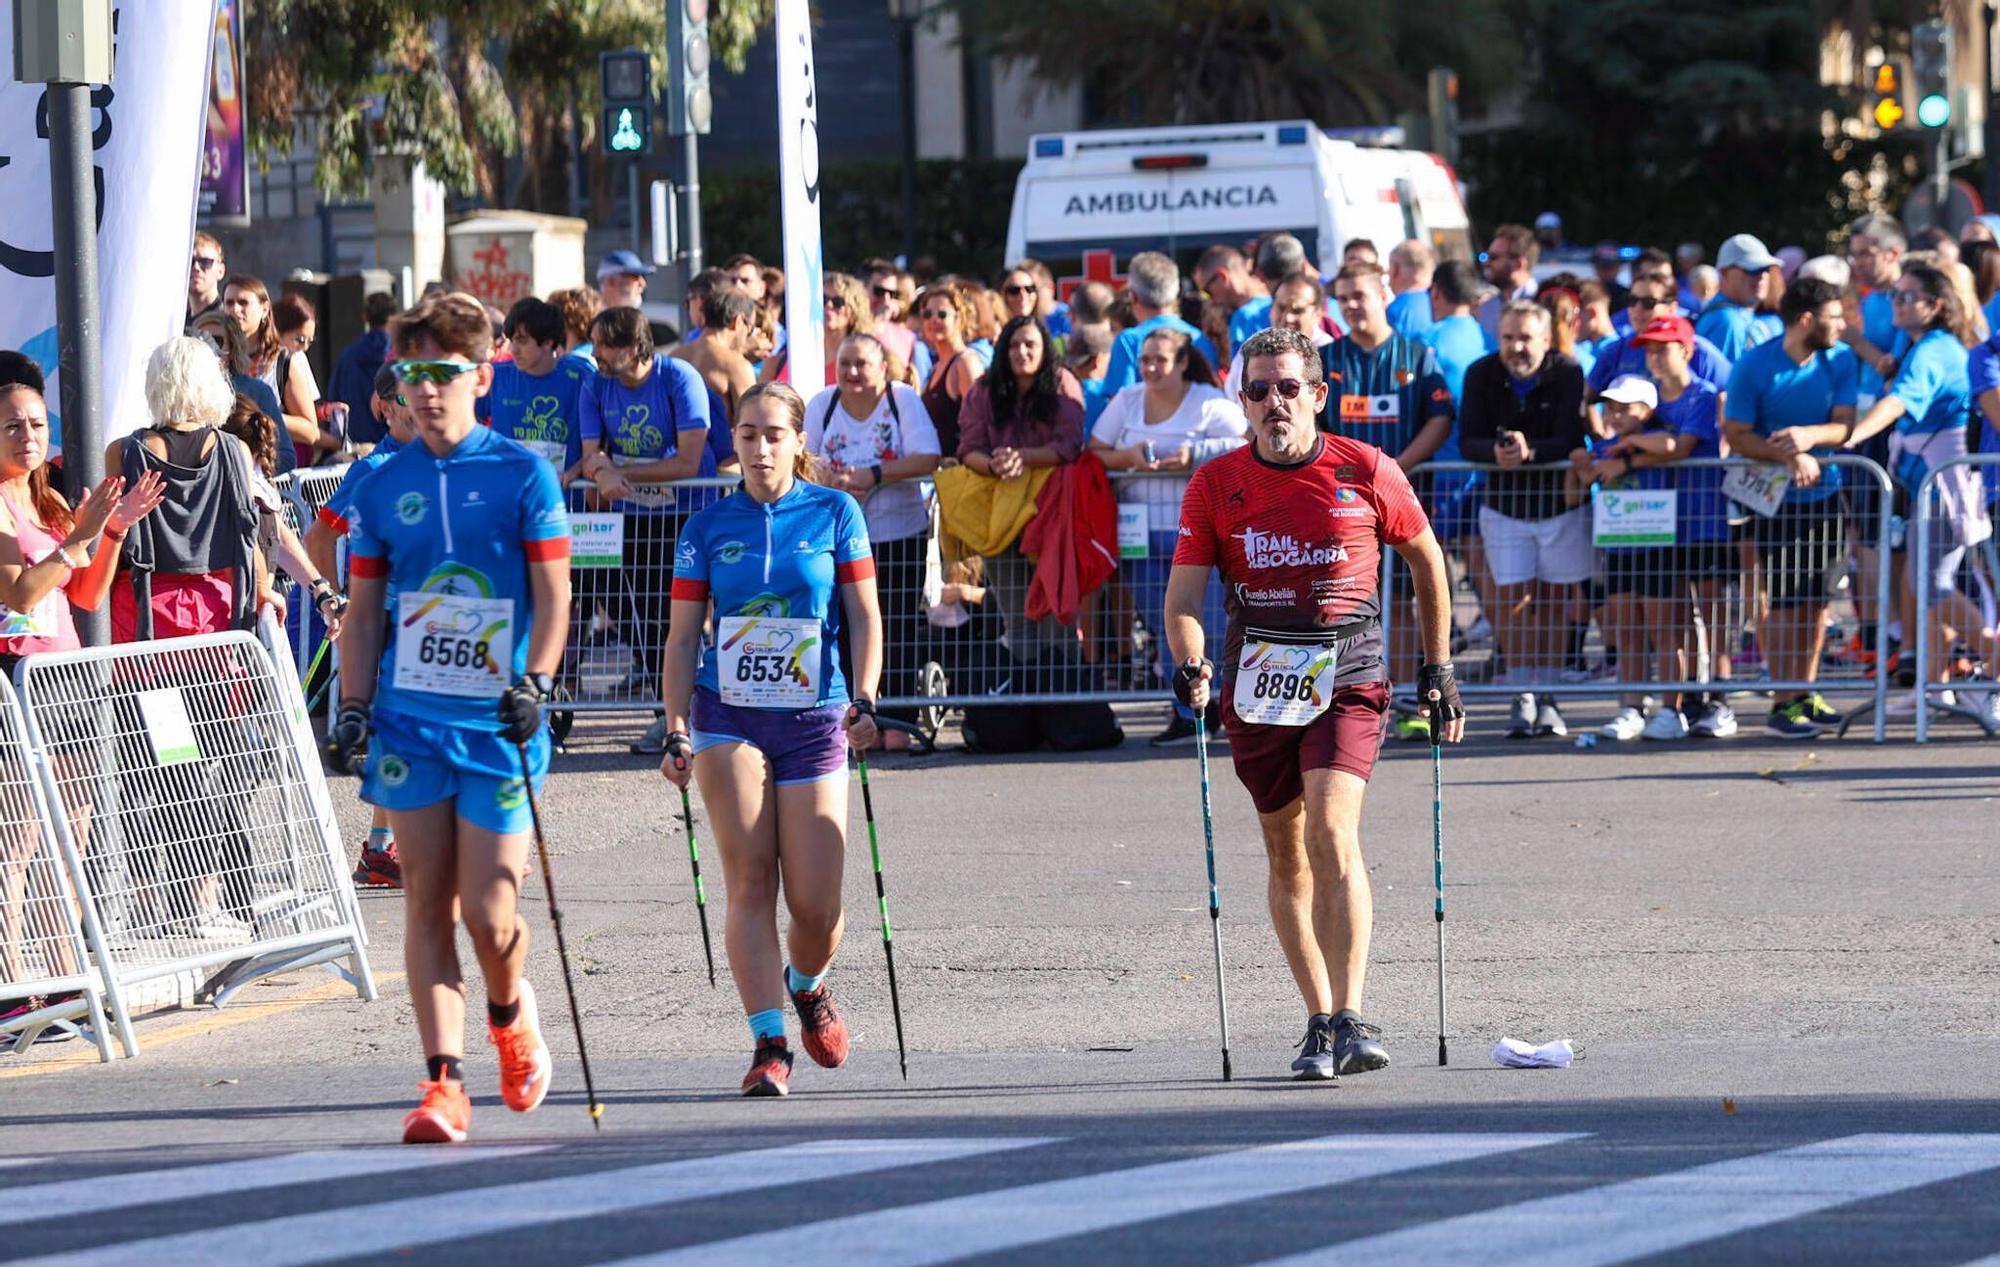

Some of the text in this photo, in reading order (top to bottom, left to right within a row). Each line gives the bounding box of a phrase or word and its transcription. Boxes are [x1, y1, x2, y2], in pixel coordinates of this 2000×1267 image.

[1064, 185, 1278, 217] AMBULANCIA
[1256, 546, 1349, 569] BOGARRA
[420, 635, 489, 669] 6568
[736, 655, 801, 683] 6534
[1254, 672, 1315, 701] 8896
